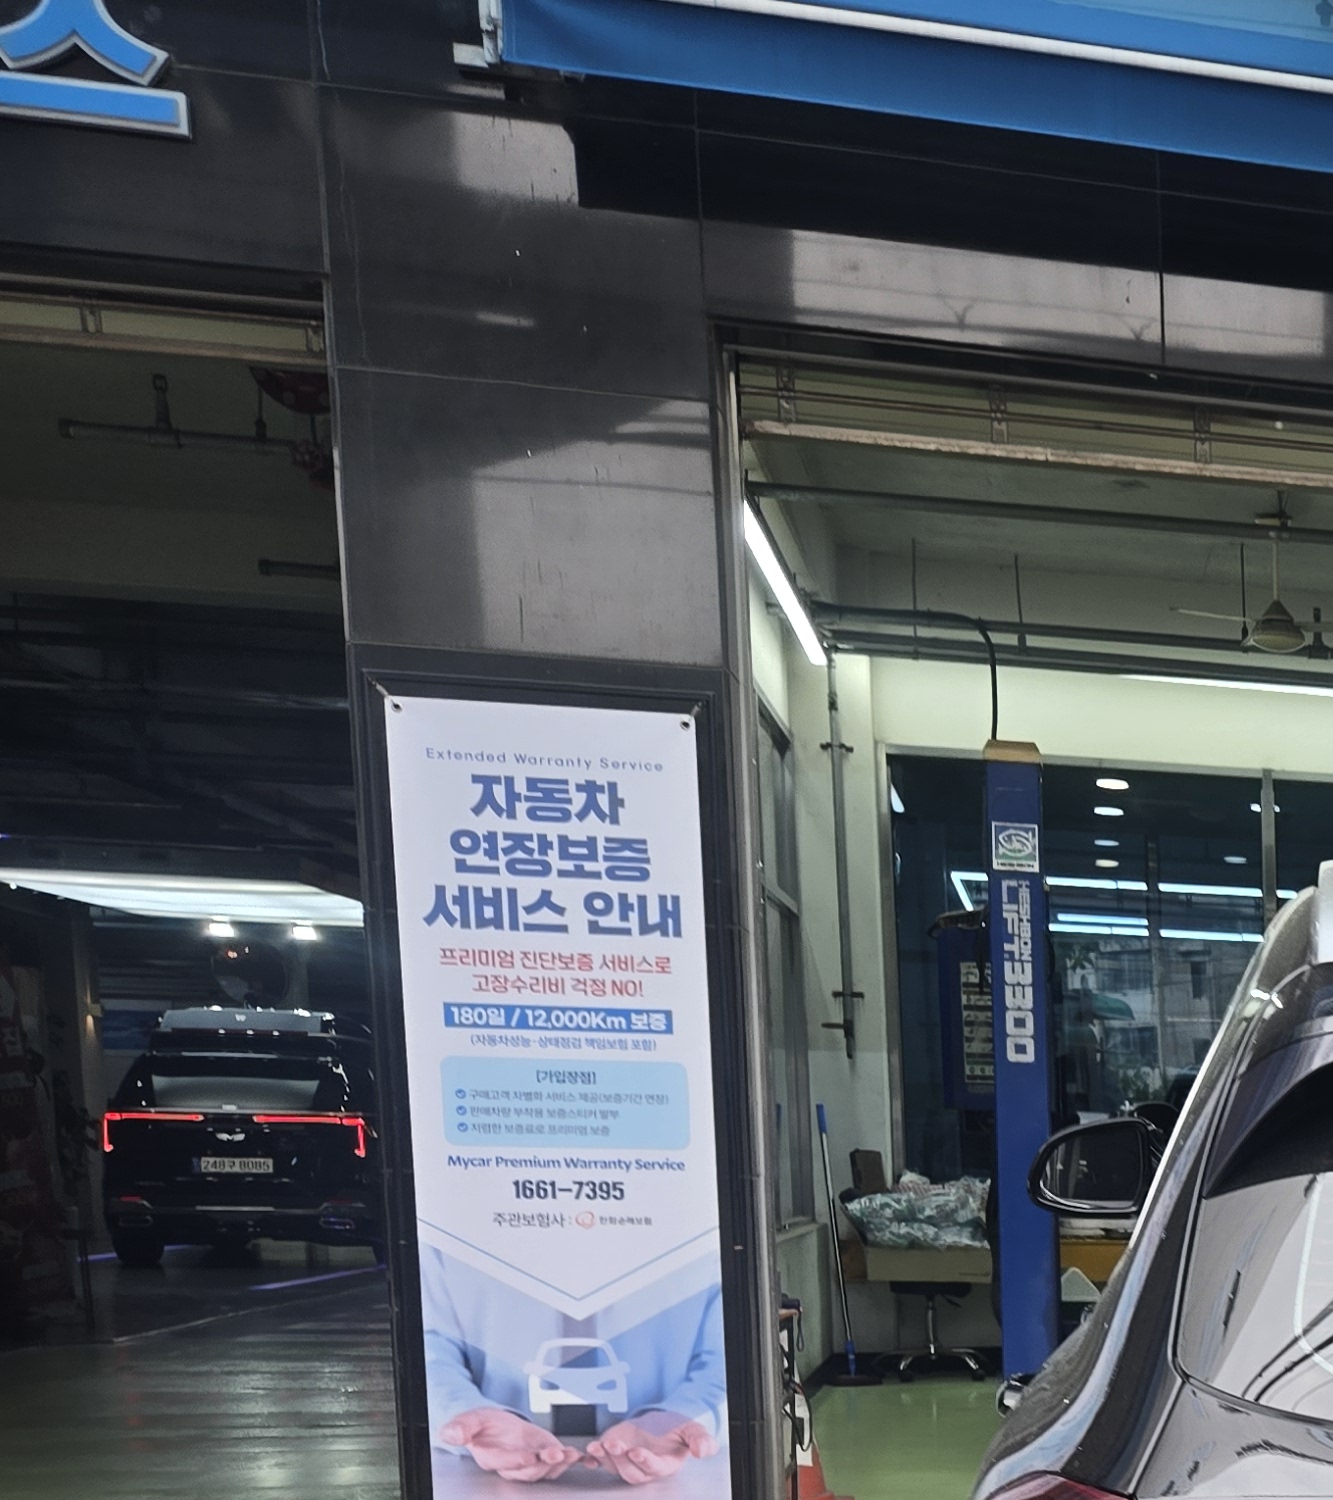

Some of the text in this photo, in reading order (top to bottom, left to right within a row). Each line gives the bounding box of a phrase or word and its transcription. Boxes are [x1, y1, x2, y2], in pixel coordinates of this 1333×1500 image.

[426, 748, 663, 772] Extended Warranty Service
[470, 774, 625, 826] 자동차
[450, 829, 652, 882] 연장보증
[422, 884, 683, 938] 서비스 안내
[1018, 879, 1033, 961] HESHBON
[439, 947, 672, 975] 프리미엄 진단보증 서비스로
[472, 973, 644, 997] 고장수리비 걱정 NO!
[450, 1006, 506, 1027] 180일
[525, 1009, 627, 1030] 12,000Km
[630, 1012, 667, 1031] 보증
[447, 1155, 686, 1173] Mycar Premium Warranty Service
[512, 1180, 625, 1200] 1661-7395
